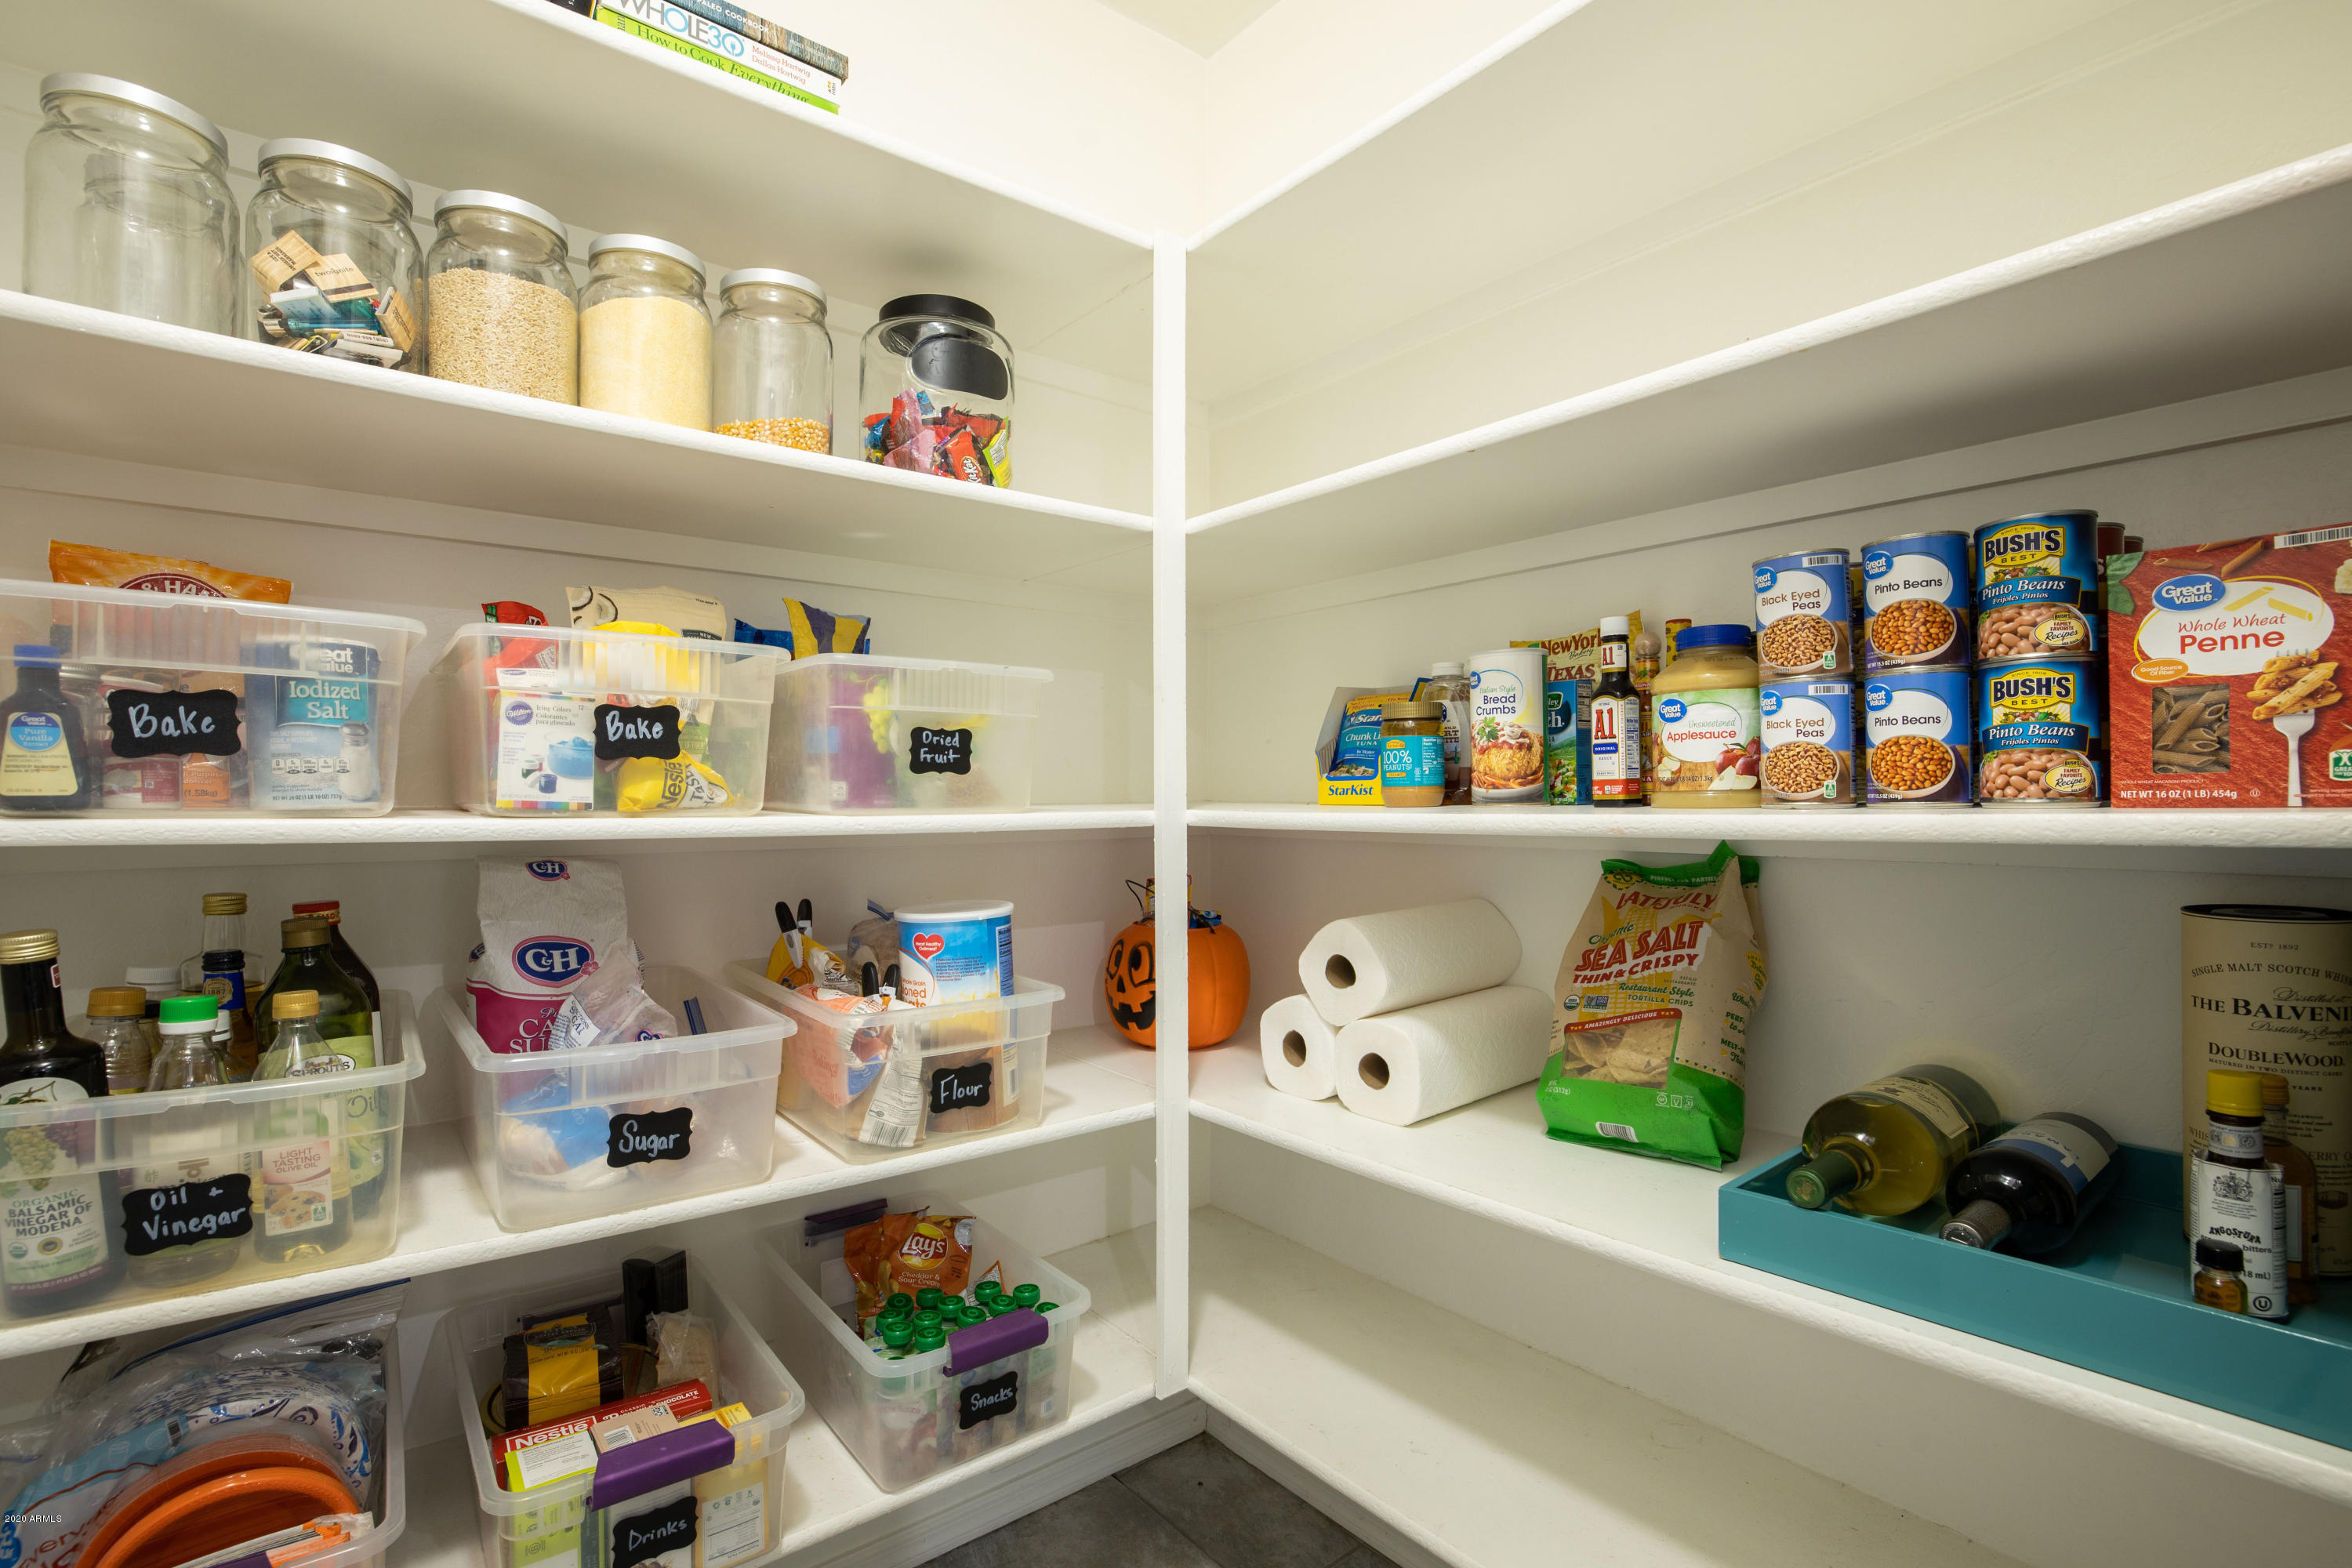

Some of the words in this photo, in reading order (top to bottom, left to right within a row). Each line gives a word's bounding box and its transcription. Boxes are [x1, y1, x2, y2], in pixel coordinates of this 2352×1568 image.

[725, 9, 769, 34] COOKBOOK
[637, 24, 671, 48] How
[674, 42, 688, 56] to
[690, 48, 725, 71] Cook
[752, 45, 781, 64] Melissa
[782, 58, 811, 78] Hartwig
[752, 55, 776, 71] Dallas
[777, 66, 806, 85] Hartwig
[1985, 529, 2062, 563] BUSH'S
[1865, 557, 1886, 570] Great
[2001, 554, 2037, 564] BEST
[1755, 572, 1771, 585] Great
[1869, 566, 1887, 575] Value
[1875, 583, 1900, 594] Pinto
[1904, 578, 1943, 590] Beans
[1983, 583, 2013, 601] Pinto
[2017, 579, 2066, 591] Beans
[2161, 581, 2213, 598] Great
[1762, 594, 1787, 606] Black
[1791, 590, 1820, 602] Eyed
[1792, 600, 1821, 611] Peas
[1993, 593, 2019, 605] Frijoles
[2021, 591, 2049, 601] Pintos
[2173, 593, 2213, 605] Value
[2178, 619, 2227, 633] Whole
[2233, 613, 2287, 628] Wheat
[2045, 629, 2078, 642] Recipes
[2180, 630, 2285, 655] Penne
[1568, 648, 1594, 660] Bakery
[1602, 646, 1615, 666] A1
[1548, 664, 1595, 682] TEXAS
[289, 681, 361, 701] Iodized
[1499, 684, 1516, 695] Style
[1866, 690, 1886, 702] Great
[1993, 676, 2072, 704] BUSH'S
[1483, 694, 1516, 705] Bread
[1761, 696, 1777, 706] Great
[1869, 698, 1886, 706] Value
[307, 700, 350, 720] Salt
[1476, 705, 1516, 716] Crumbs
[1661, 704, 1681, 713] Great
[128, 703, 216, 739] Bake
[604, 710, 664, 742] Bake
[1594, 707, 1617, 739] A1
[1688, 717, 1737, 728] Unsweetened
[1766, 719, 1791, 730] Black
[1795, 717, 1824, 730] Eyed
[1875, 716, 1898, 727] Pinto
[1902, 715, 1941, 725] Beans
[922, 731, 960, 748] Dried
[1345, 732, 1371, 742] Chunk
[1667, 730, 1737, 742] Applesauce
[1796, 728, 1824, 738] Peas
[1989, 726, 2023, 740] Pinto
[2027, 724, 2076, 737] Beans
[2001, 738, 2030, 746] Frijoles
[920, 750, 960, 764] Fruit
[1383, 750, 1412, 764] 100%
[1328, 783, 1374, 796] StarKist
[2055, 776, 2086, 788] Recipes
[183, 789, 218, 798] (1.58kg)
[2183, 790, 2191, 799] (1
[2194, 790, 2210, 799] LB)
[2212, 790, 2238, 799] 454g
[531, 862, 561, 875] C&H
[1616, 891, 1663, 909] LATE
[1653, 892, 1719, 910] JULY
[1588, 922, 1635, 946] Organic
[1574, 938, 1628, 972] SEA
[1632, 920, 1704, 960] SALT
[524, 946, 581, 974] C&H
[1573, 971, 1613, 984] THIN
[1613, 968, 1626, 978] &
[1628, 953, 1700, 976] CRISPY
[2191, 964, 2223, 978] SINGLE
[2228, 964, 2263, 972] MALT
[2268, 964, 2320, 978] SCOTCH
[1618, 982, 1668, 994] Restaurant
[1669, 986, 1694, 998] Style
[2274, 986, 2333, 1003] Distilled
[1628, 994, 1665, 1004] TORTILLA
[1668, 998, 1693, 1007] CHIPS
[2191, 995, 2225, 1013] THE
[1584, 1018, 1621, 1029] AMAZINGLY
[1623, 1011, 1657, 1022] DELICIOUS
[2209, 1058, 2244, 1068] MATURED
[2281, 1068, 2320, 1076] DISTINCT
[940, 1073, 983, 1105] Flour
[347, 1091, 379, 1119] Oil
[618, 1120, 681, 1158] Sugar
[272, 1154, 321, 1167] TASTING
[279, 1148, 313, 1159] LIGHT
[276, 1164, 302, 1173] OLIVE
[8, 1194, 86, 1218] BALSAMIC
[12, 1189, 78, 1208] ORGANIC
[151, 1186, 187, 1211] Oil
[5, 1210, 68, 1228] VINEGAR
[74, 1201, 93, 1215] OF
[16, 1216, 82, 1237] MODENA
[142, 1207, 246, 1241] Vinegar
[2209, 1226, 2262, 1244] ANGOSTURA
[902, 1233, 946, 1259] Lay's
[2243, 1245, 2272, 1254] bitters
[902, 1271, 933, 1279] Cheddar
[917, 1277, 940, 1287] Cream
[971, 1387, 1014, 1411] Snacks
[620, 1403, 646, 1414] CLASSIC
[629, 1519, 687, 1552] Drinks
